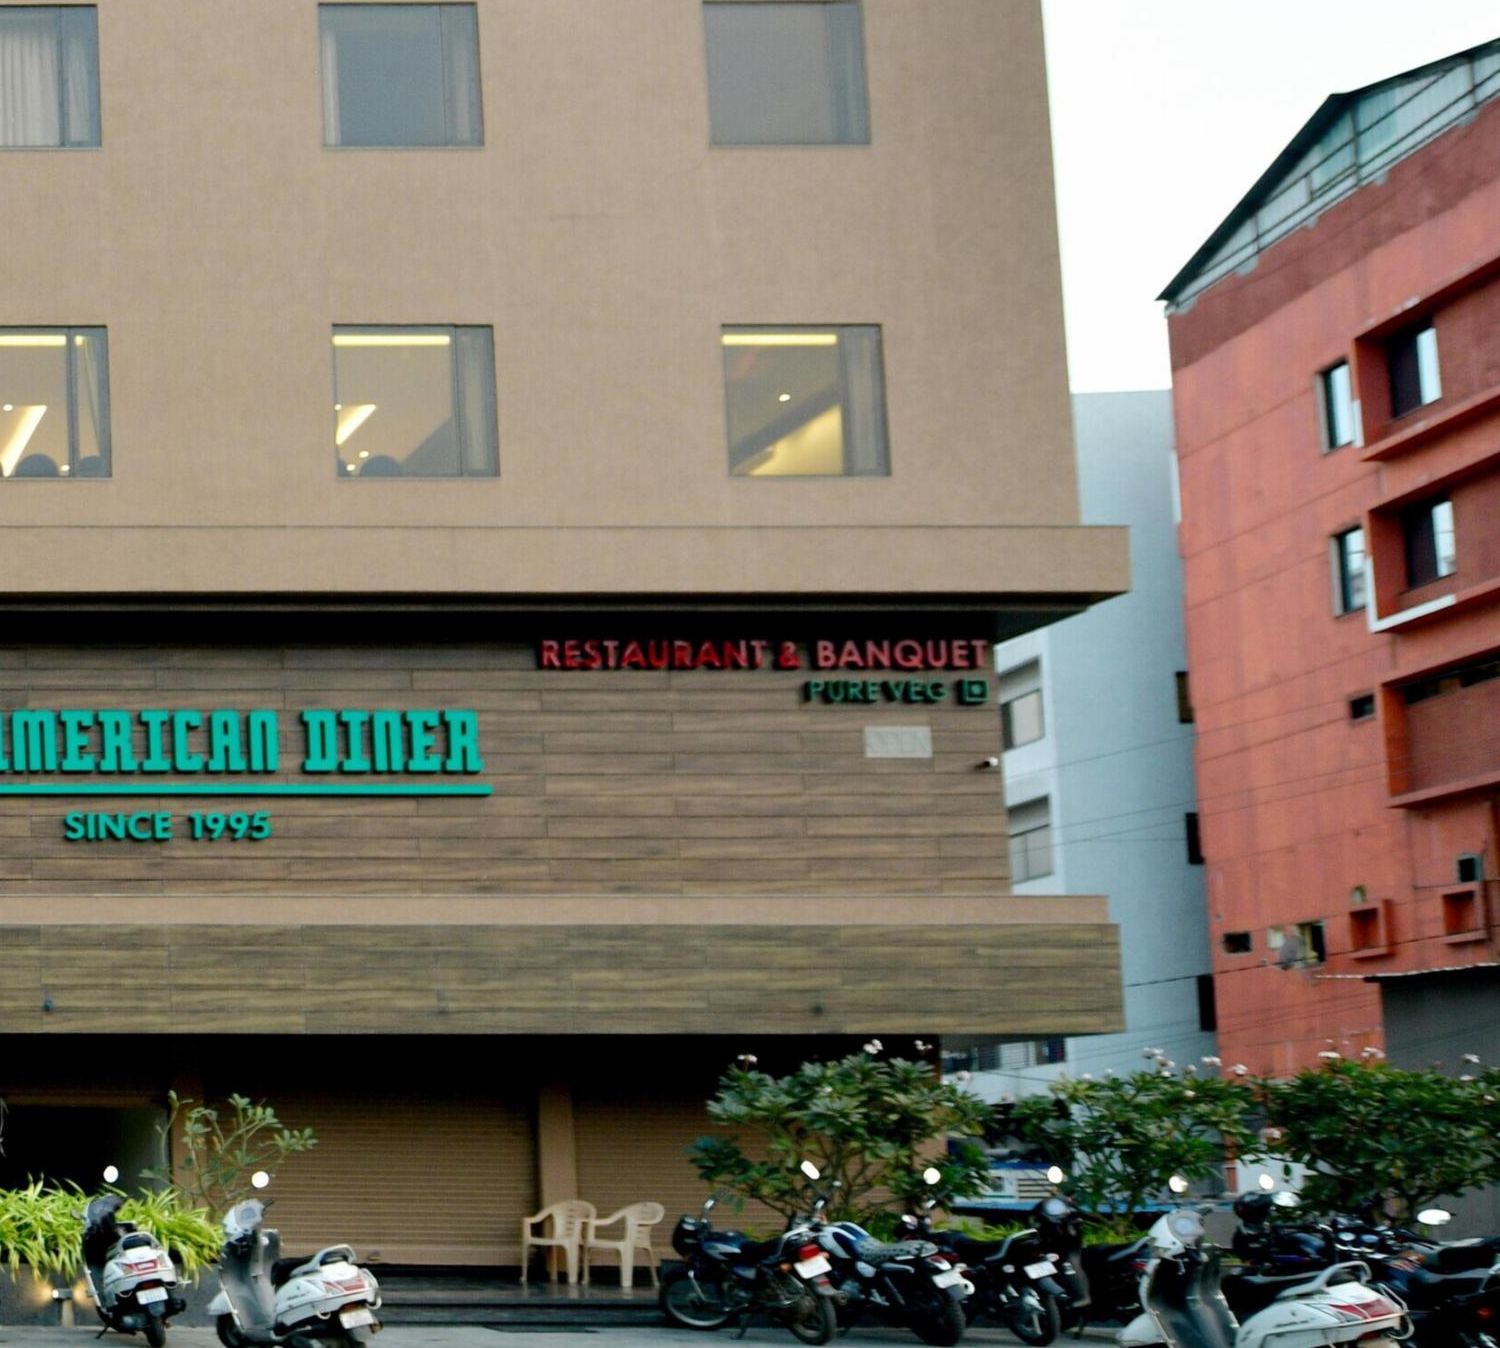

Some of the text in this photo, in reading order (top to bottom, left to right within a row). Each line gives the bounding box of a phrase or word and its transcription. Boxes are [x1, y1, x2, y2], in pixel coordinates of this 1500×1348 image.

[541, 639, 988, 669] RESTAURANT & BANQUET
[808, 680, 947, 701] PURE VEG
[300, 709, 483, 773] DINER
[63, 812, 272, 840] SINCE 1995
